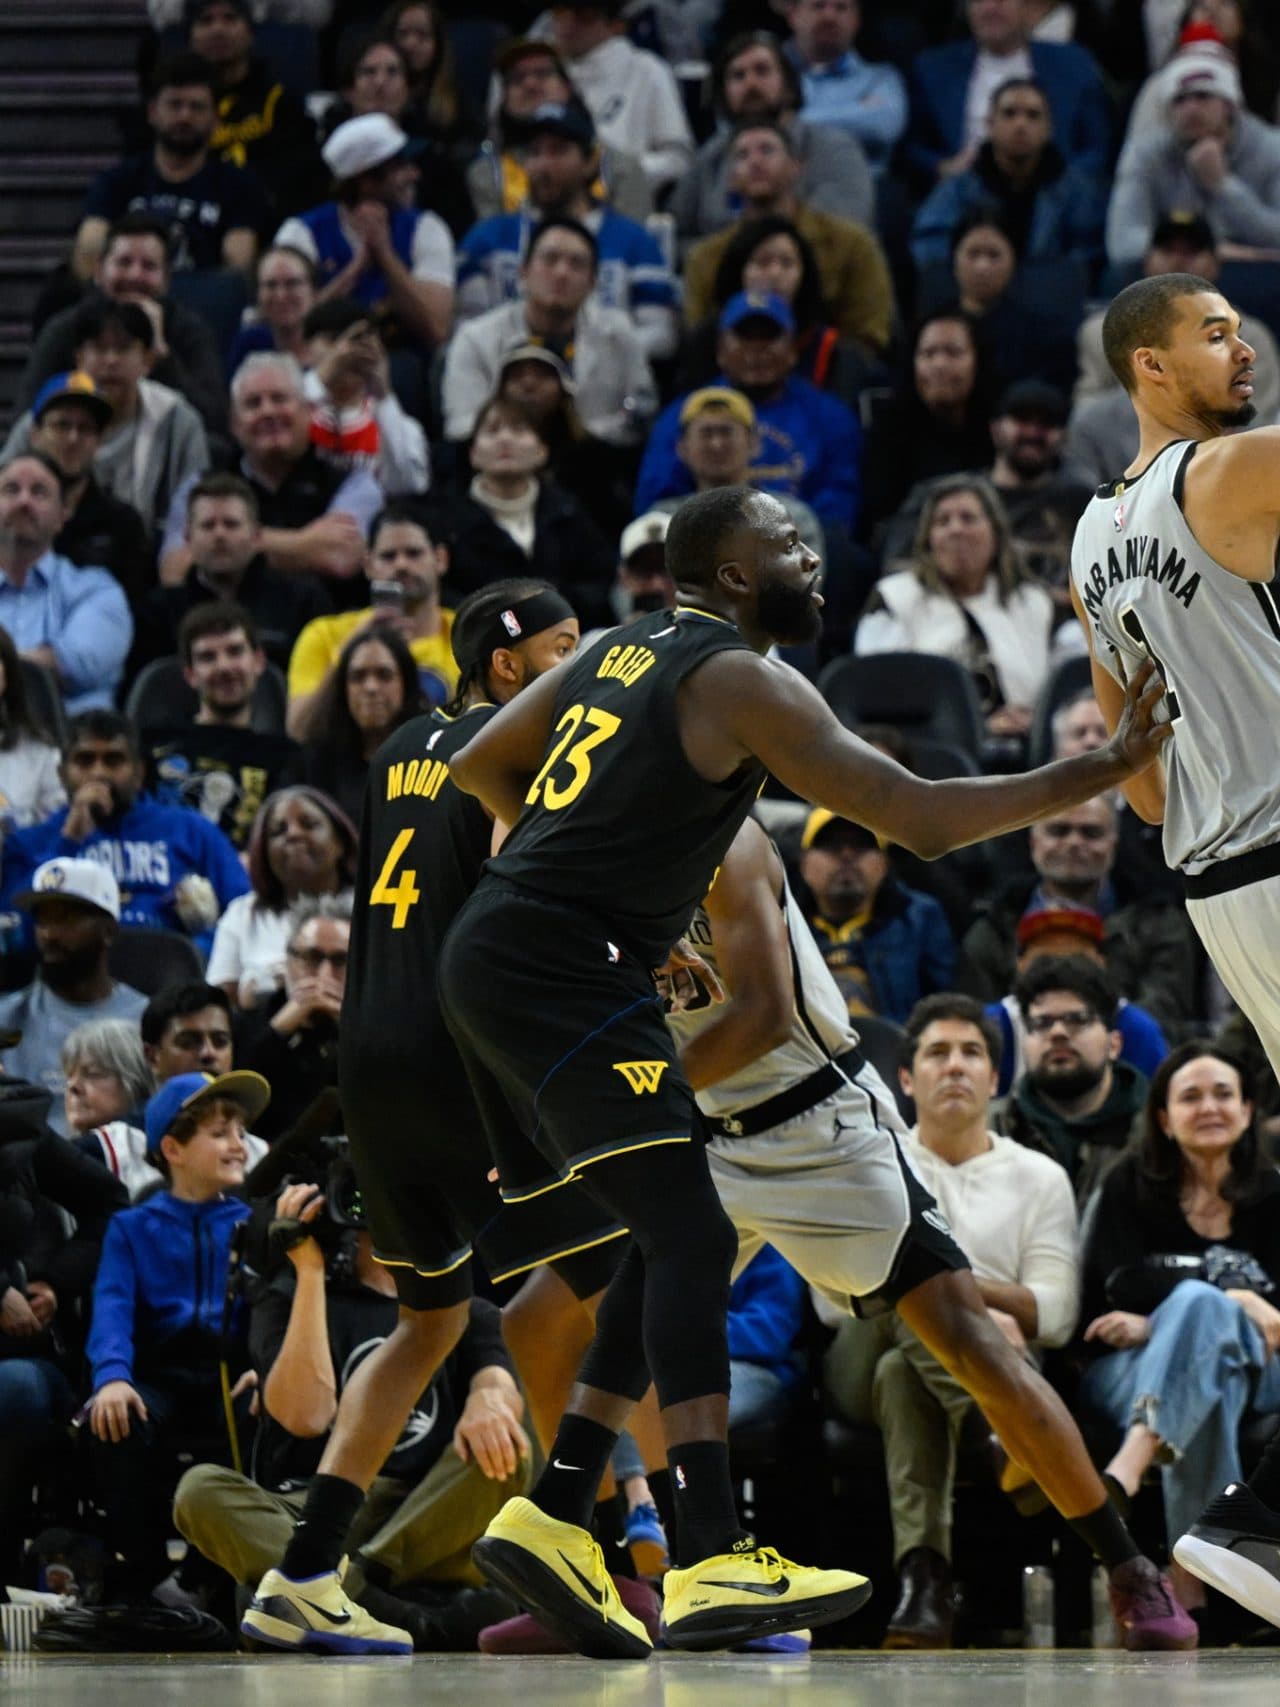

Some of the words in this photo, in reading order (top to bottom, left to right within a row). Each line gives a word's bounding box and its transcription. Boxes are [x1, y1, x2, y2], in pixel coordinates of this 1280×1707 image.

[1084, 535, 1201, 652] MBANYAMA
[387, 758, 450, 801] MOODY
[524, 703, 623, 811] 23
[369, 827, 421, 930] 4
